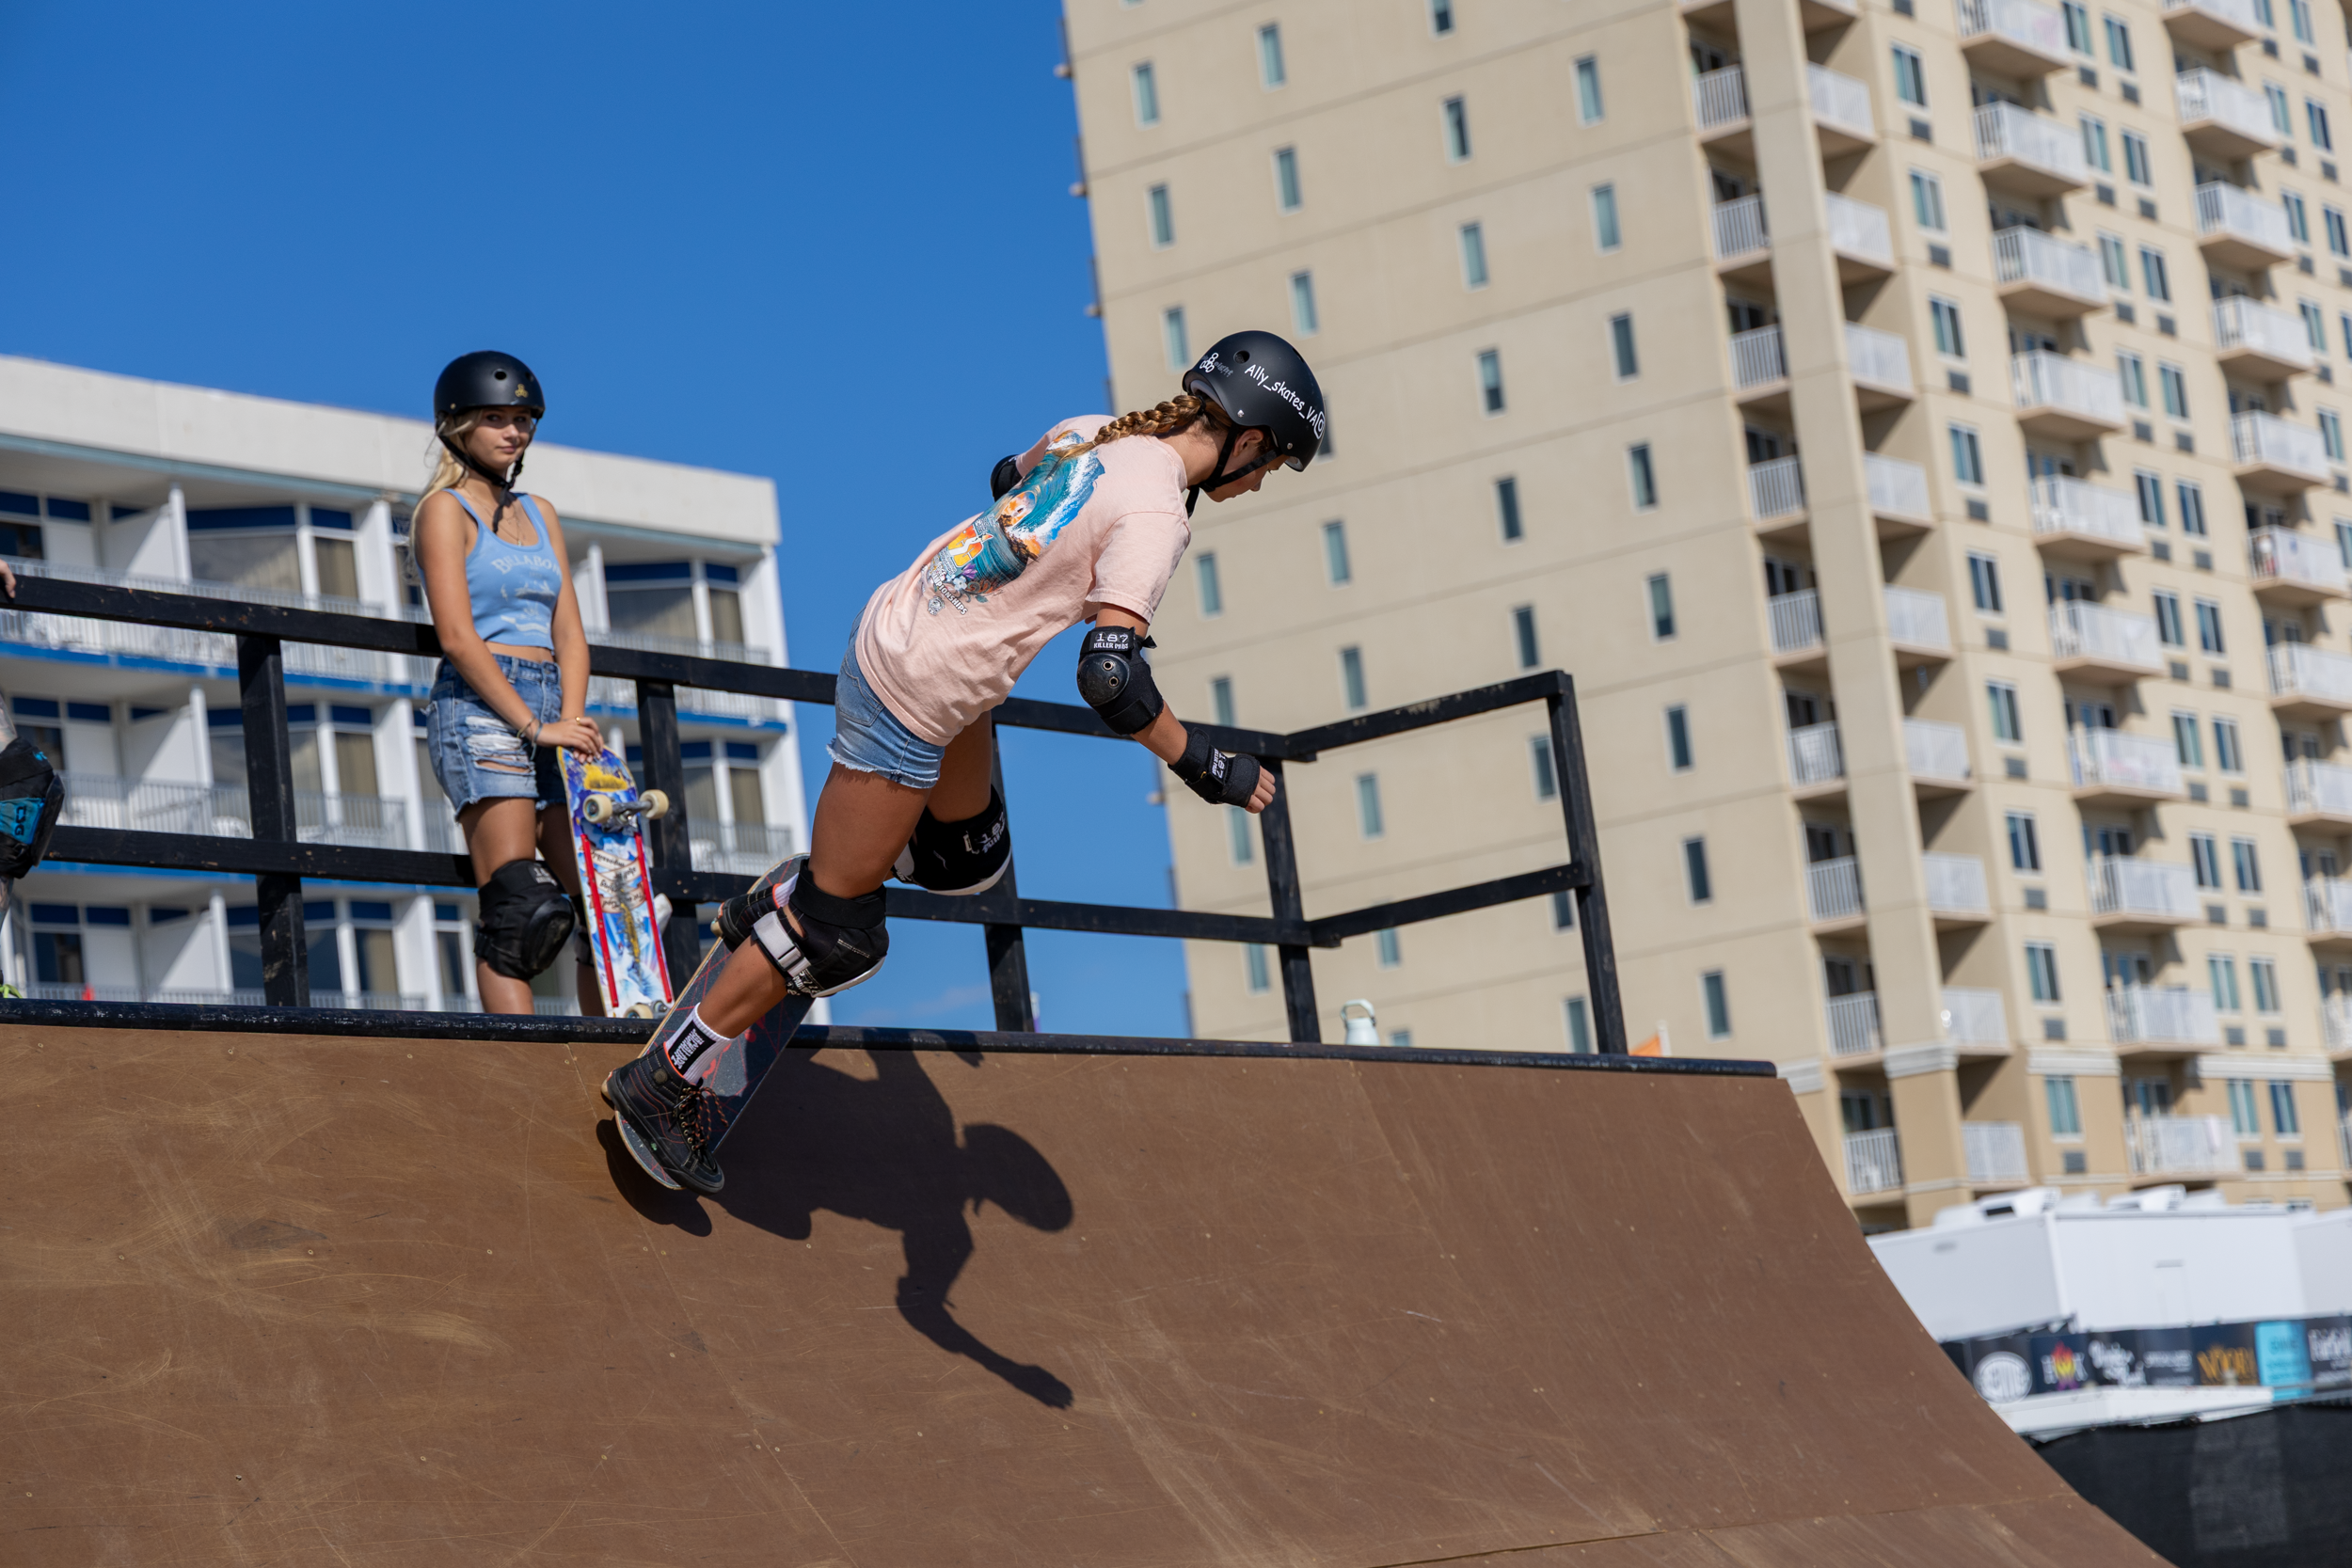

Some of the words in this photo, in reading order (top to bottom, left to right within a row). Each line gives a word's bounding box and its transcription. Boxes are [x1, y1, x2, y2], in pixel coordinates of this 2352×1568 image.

[491, 555, 563, 578] BILLABON
[1095, 632, 1129, 642] 187
[671, 1028, 705, 1069] JACKALOPE
